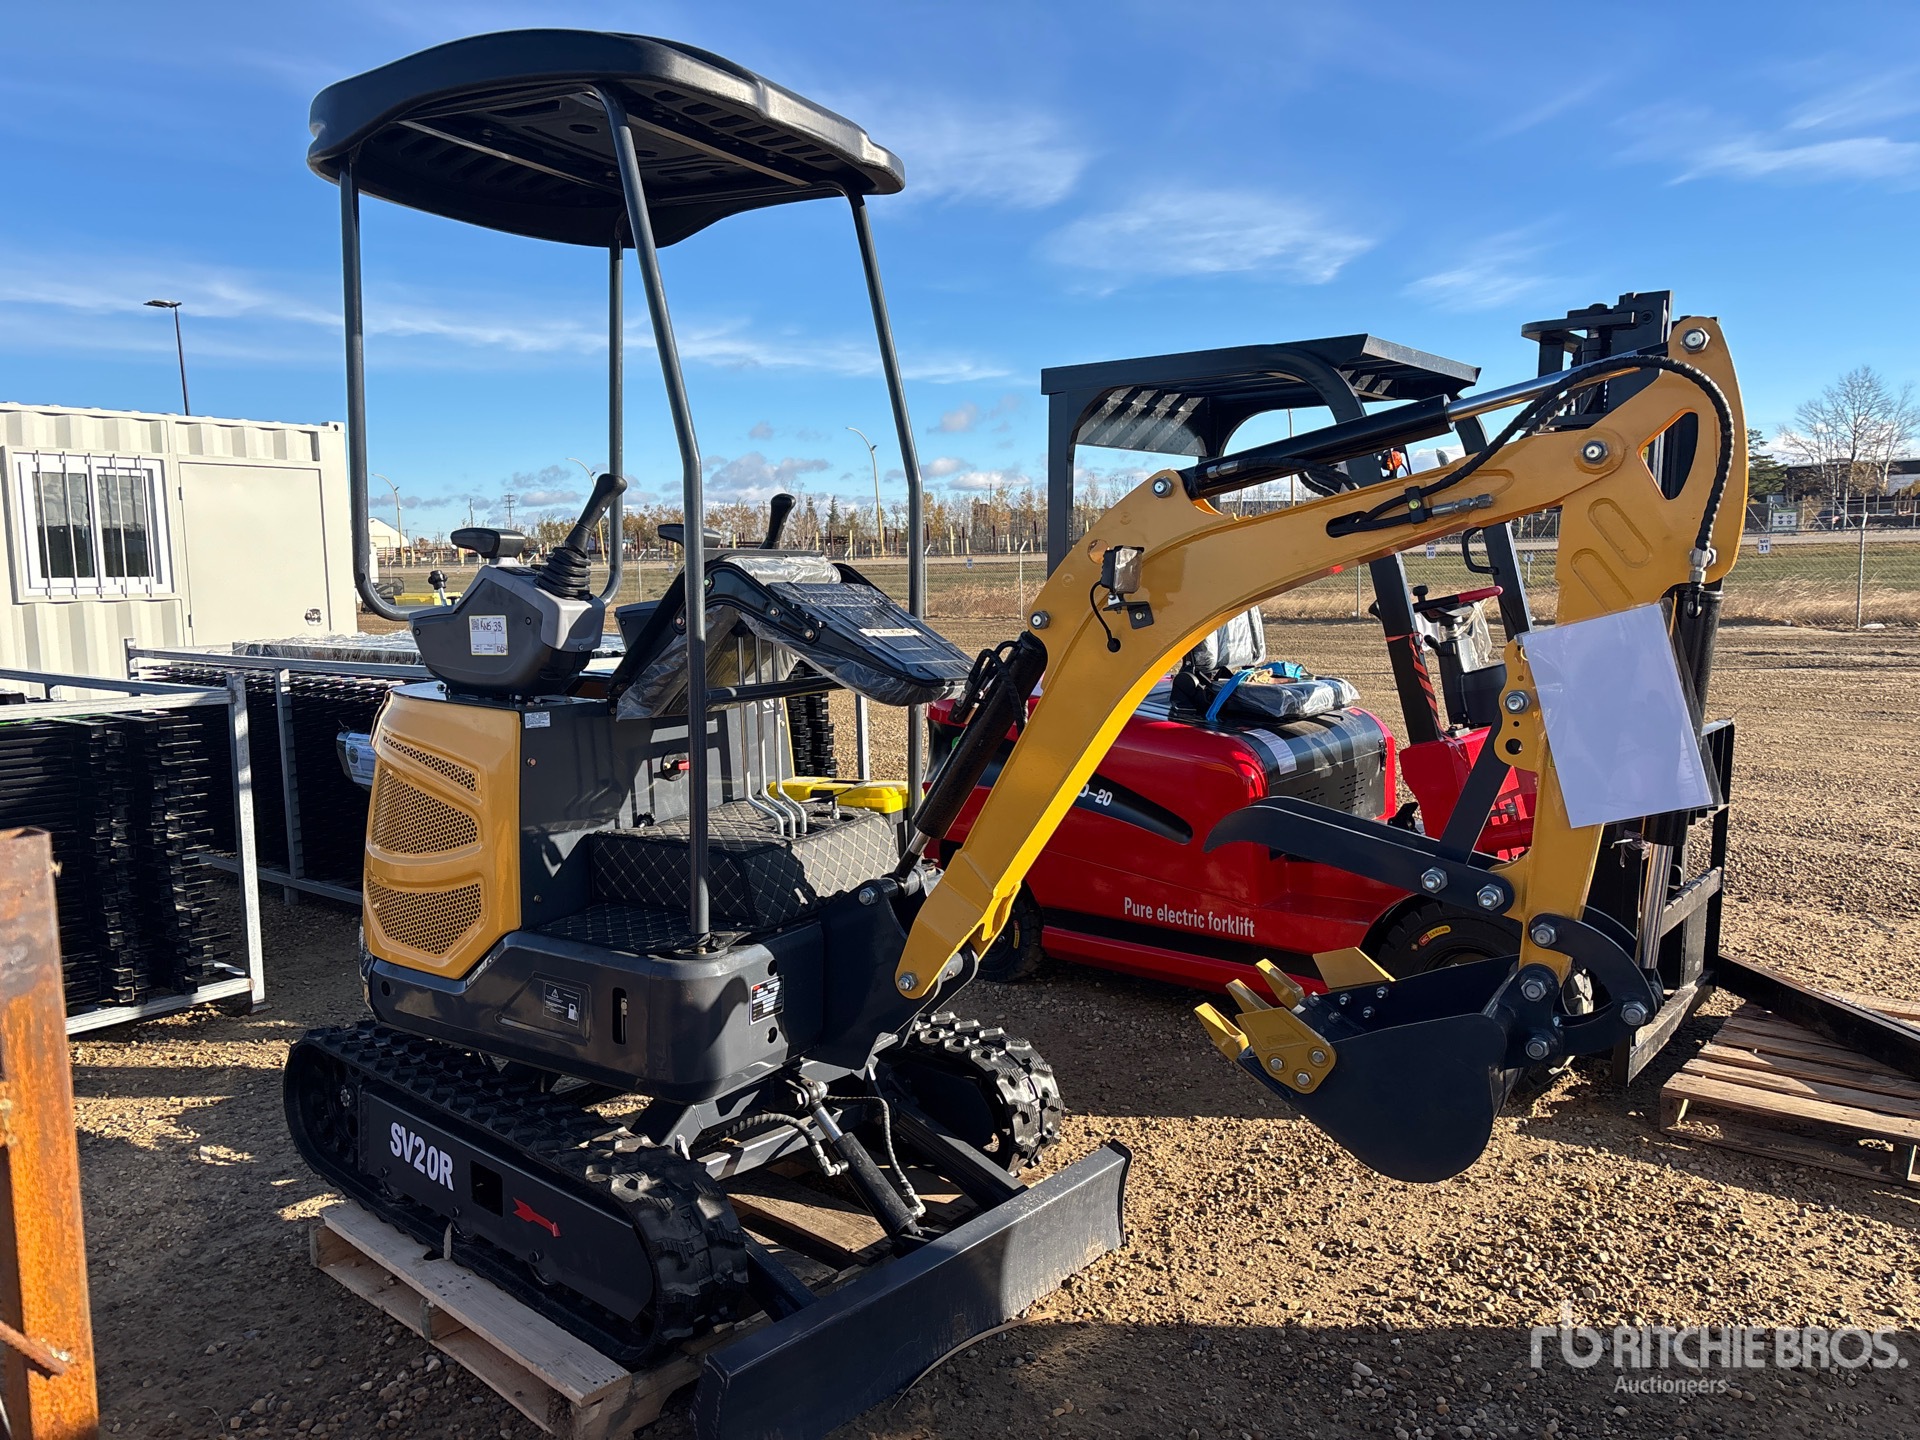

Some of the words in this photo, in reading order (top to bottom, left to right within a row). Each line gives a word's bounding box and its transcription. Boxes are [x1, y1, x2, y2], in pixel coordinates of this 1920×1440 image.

[1124, 896, 1153, 920] Pure
[1156, 903, 1205, 929] electric
[1207, 911, 1255, 938] forklift
[390, 1122, 454, 1191] SV20R
